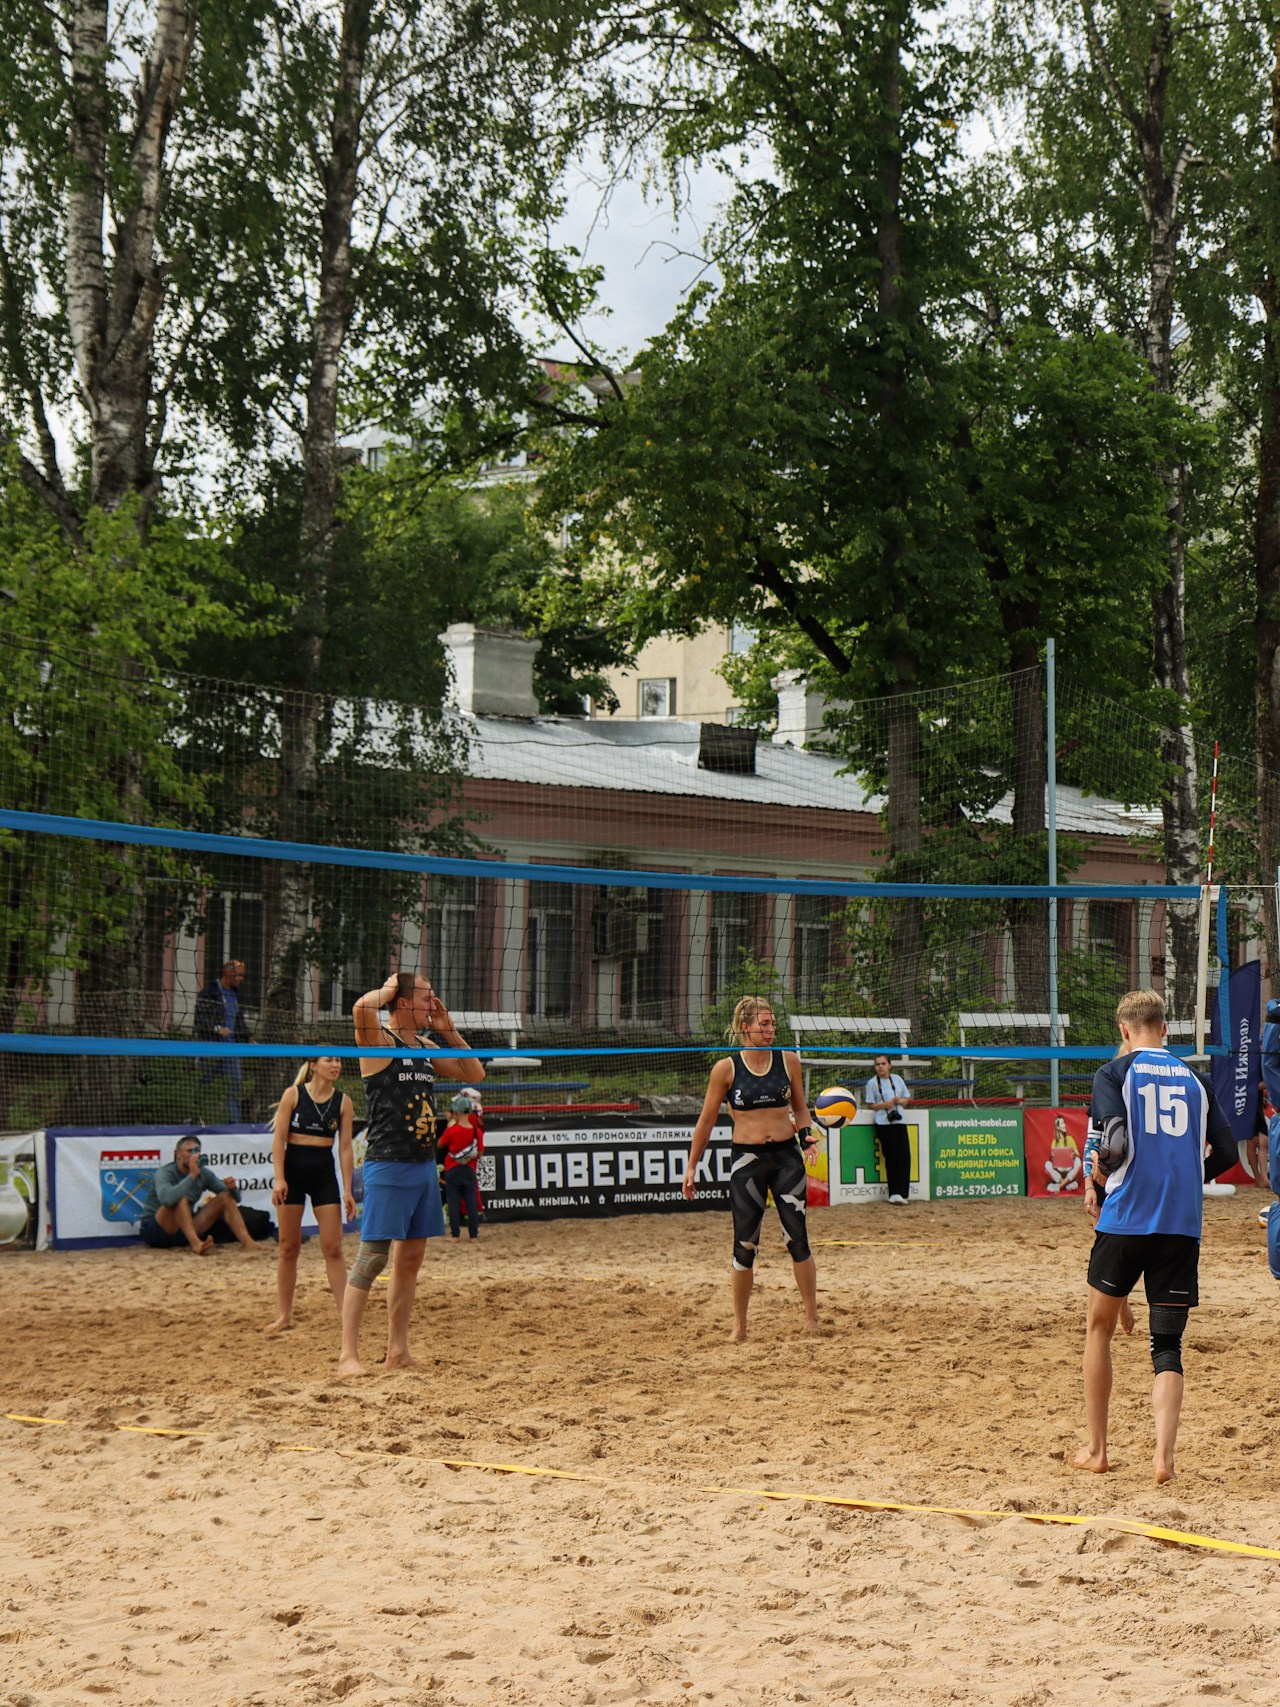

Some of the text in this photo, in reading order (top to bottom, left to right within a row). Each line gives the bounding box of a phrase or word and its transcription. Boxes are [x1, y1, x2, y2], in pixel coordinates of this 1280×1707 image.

[1235, 1018, 1252, 1116] «ВК Ижора»
[735, 1089, 742, 1100] 2
[1138, 1083, 1188, 1137] 15
[936, 1118, 1018, 1128] www.proekt-mebel.com
[510, 1134, 547, 1144] СКИДКА
[552, 1133, 570, 1142] 10%
[575, 1132, 587, 1141] ПО
[592, 1131, 648, 1141] ПРОМОКОДУ
[957, 1134, 998, 1145] МЕБЕЛЬ
[940, 1148, 1014, 1158] ДЛЯ ДОМА И ОФИСА
[503, 1148, 732, 1191] ШАВЕРБОКС
[935, 1159, 1020, 1169] ПО ИНДИВИДУАЛЬНЫМ
[960, 1171, 996, 1179] ЗАКАЗАМ
[840, 1186, 878, 1197] ПРОЕКТ
[936, 1184, 1019, 1197] 8-921-570-10-13
[487, 1198, 534, 1209] ГЕНЕРАЛА
[539, 1196, 578, 1207] КНЫША,
[579, 1195, 591, 1205] 1А
